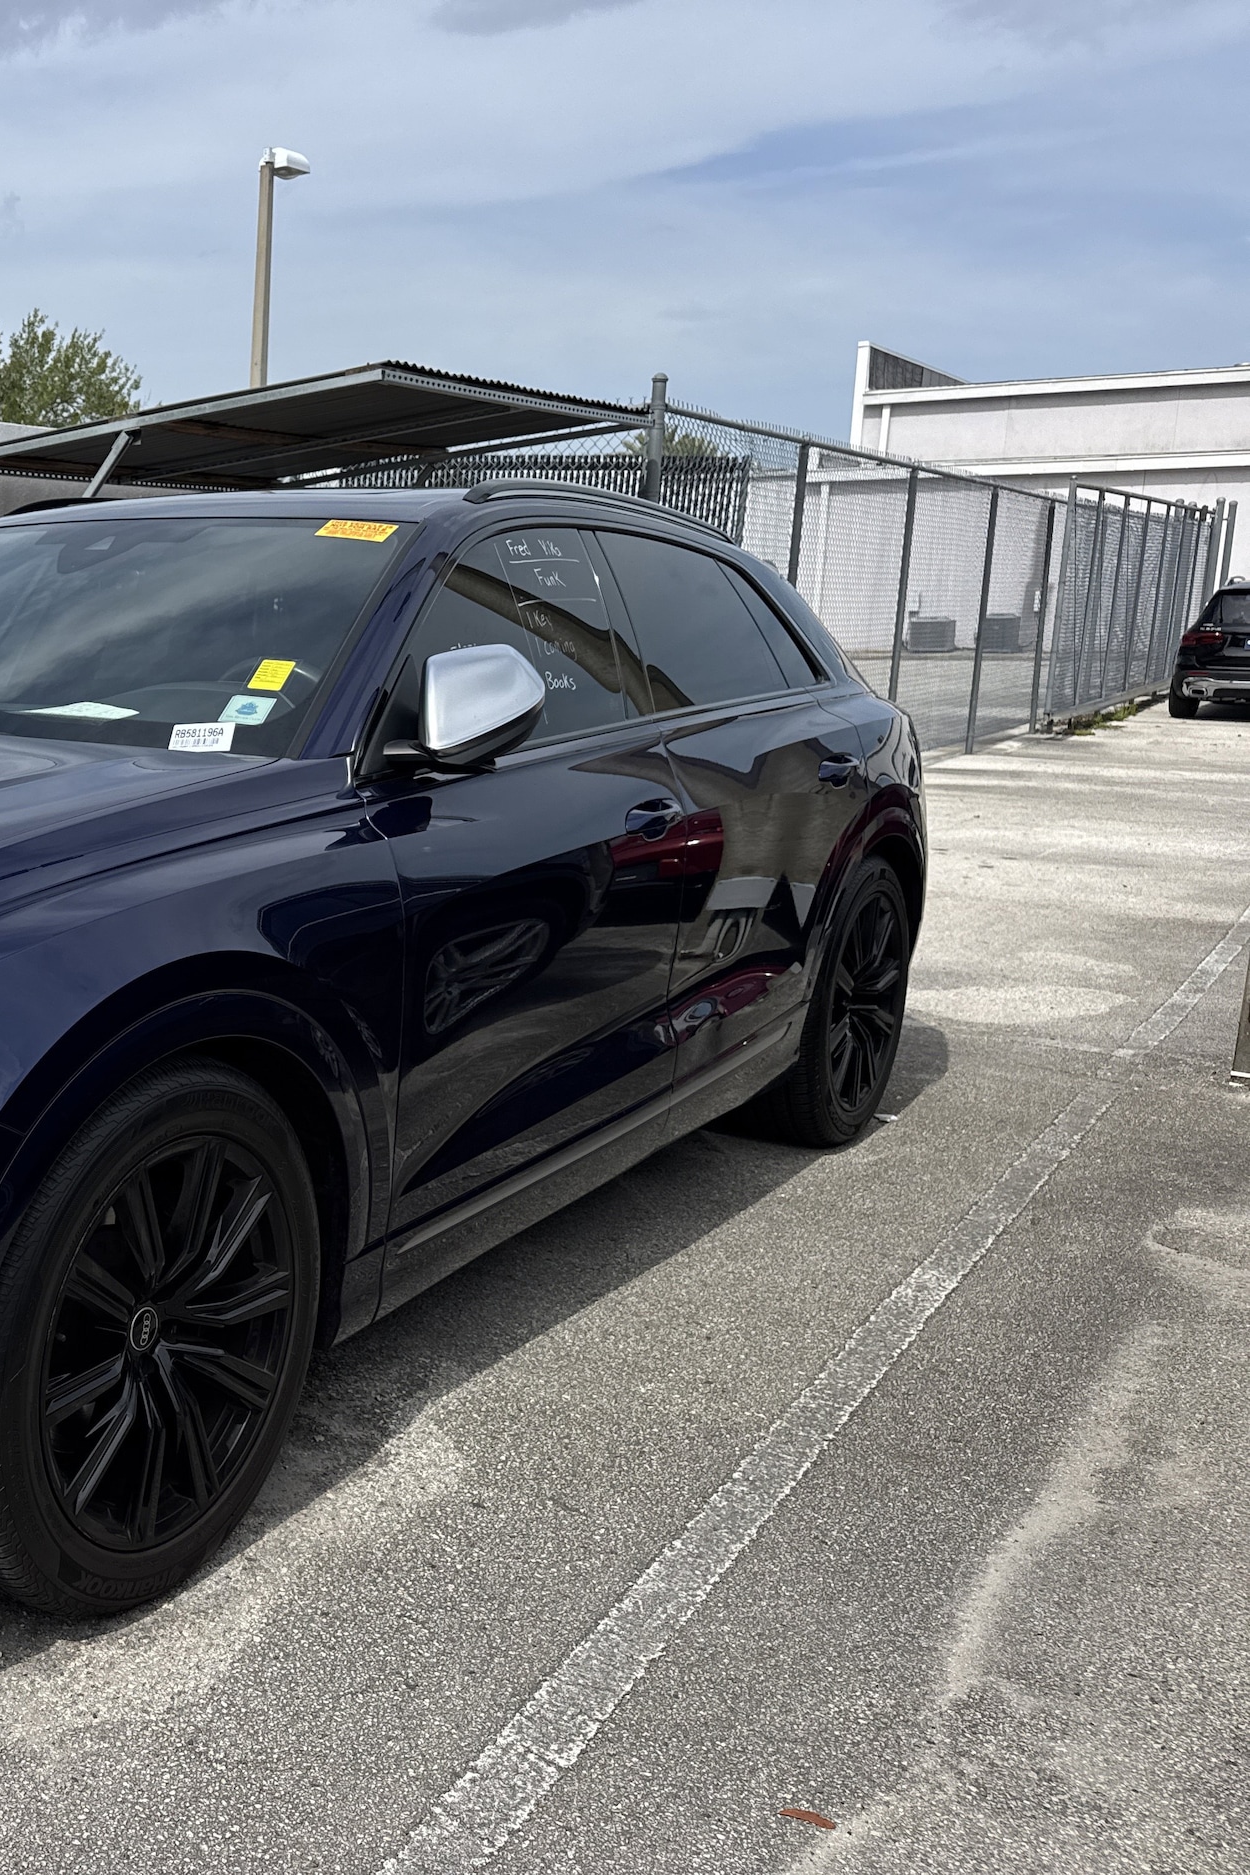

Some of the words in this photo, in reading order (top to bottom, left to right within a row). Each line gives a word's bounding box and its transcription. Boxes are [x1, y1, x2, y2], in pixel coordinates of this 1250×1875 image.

[505, 538, 531, 556] Fred
[533, 567, 567, 588] Funk
[544, 671, 577, 690] Books
[174, 727, 224, 739] RB581196A
